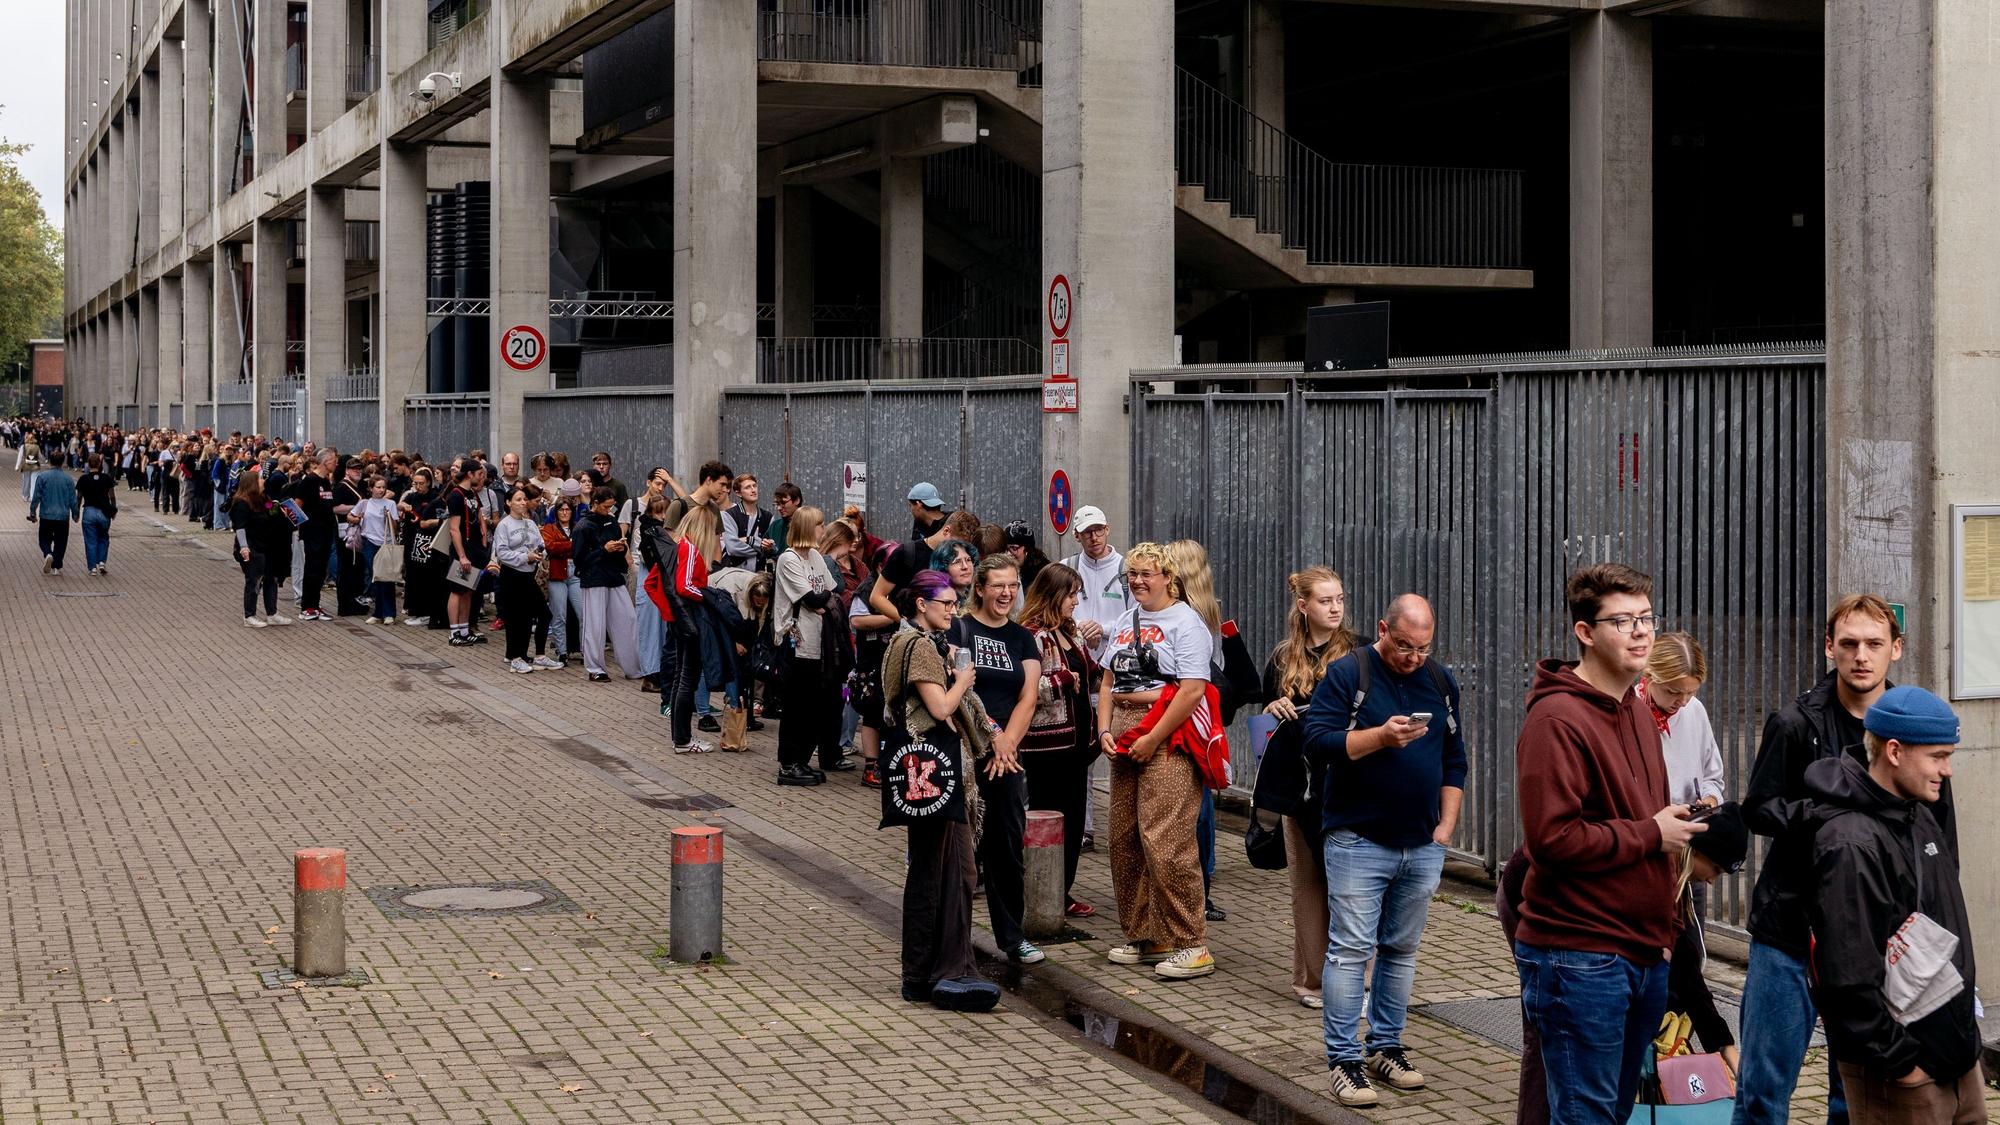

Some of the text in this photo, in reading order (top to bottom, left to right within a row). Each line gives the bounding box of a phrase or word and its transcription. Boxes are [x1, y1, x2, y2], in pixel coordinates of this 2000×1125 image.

[1053, 292, 1067, 320] 7,5t
[511, 338, 537, 358] 20
[977, 638, 1003, 649] KRAFT
[978, 644, 1005, 654] KLUB
[978, 652, 1008, 662] TOUR
[978, 659, 1010, 669] 2018
[889, 743, 952, 770] WENN ICH TOT BIN
[891, 779, 956, 817] FANG ICH WIEDER AN
